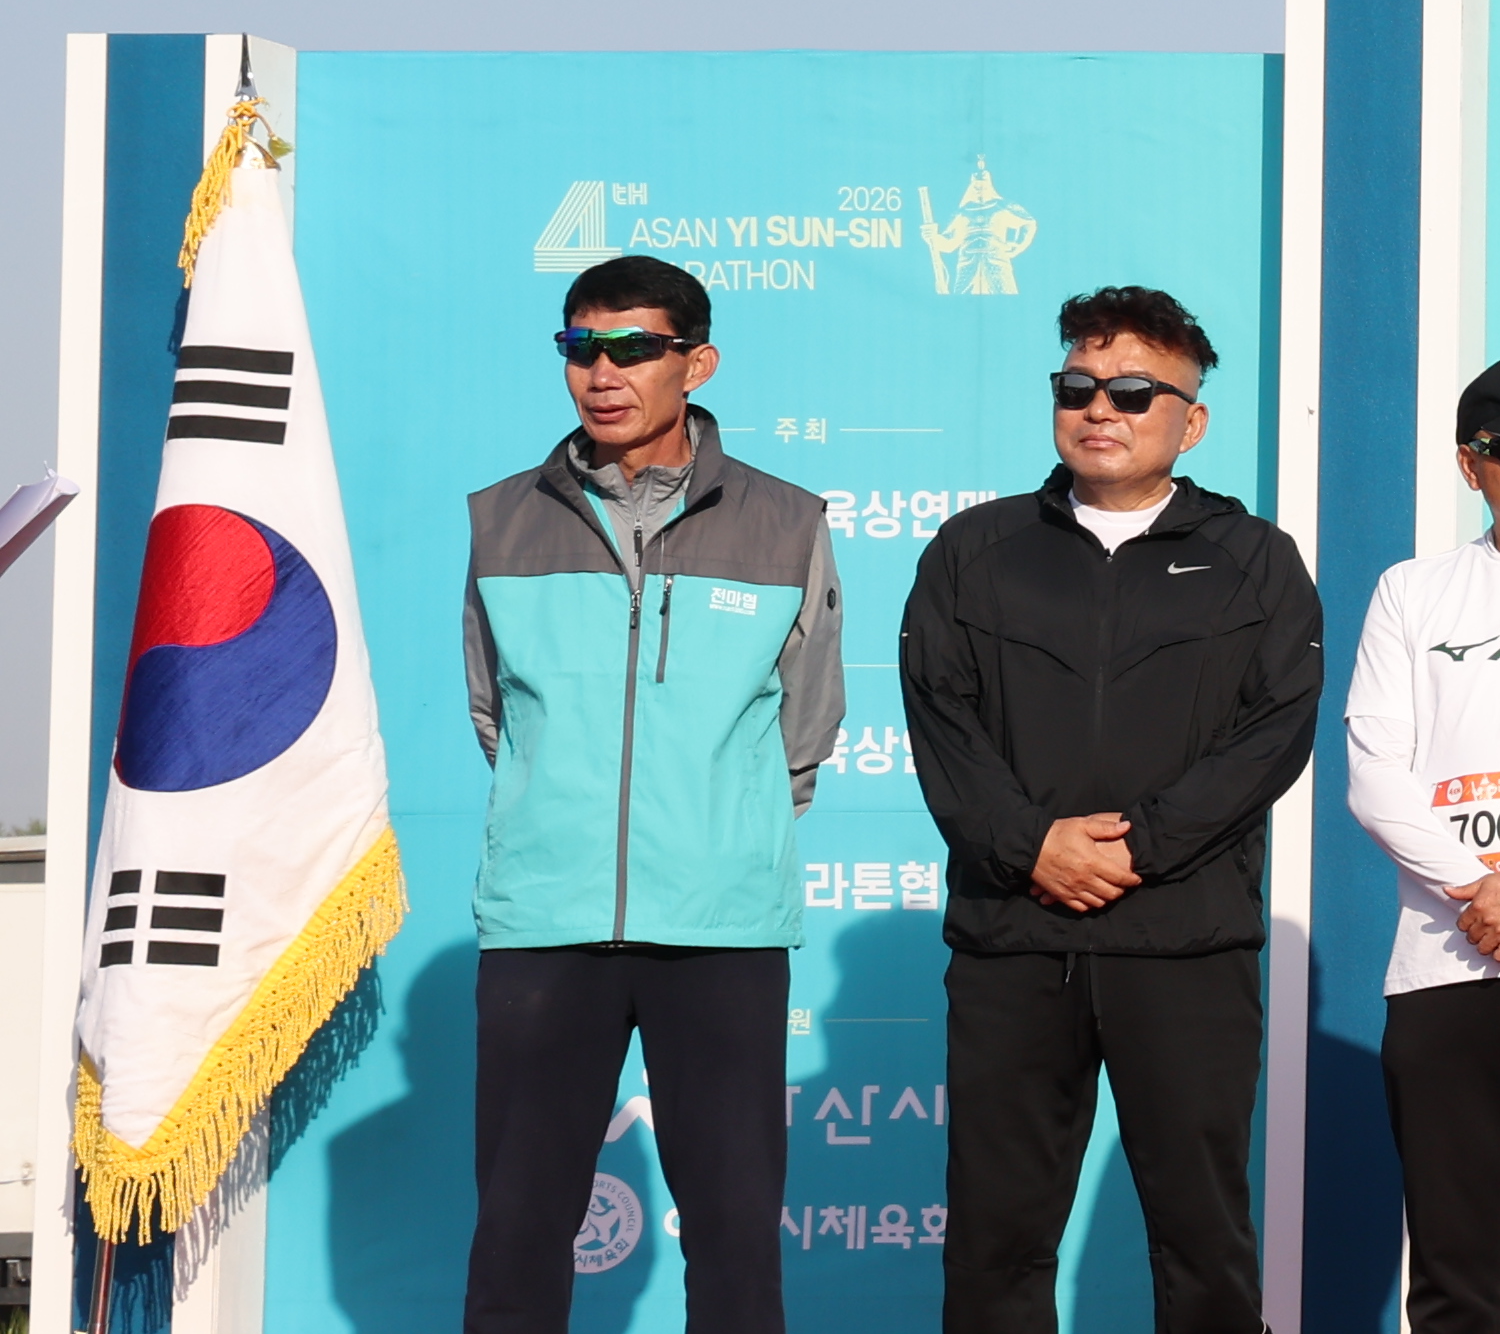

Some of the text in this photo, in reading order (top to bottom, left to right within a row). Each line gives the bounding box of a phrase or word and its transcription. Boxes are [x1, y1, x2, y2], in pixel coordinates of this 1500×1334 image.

[837, 185, 903, 212] 2026
[628, 215, 902, 249] ASAN YI SUN-SIN
[683, 258, 815, 291] RATHON
[775, 417, 826, 444] 주최
